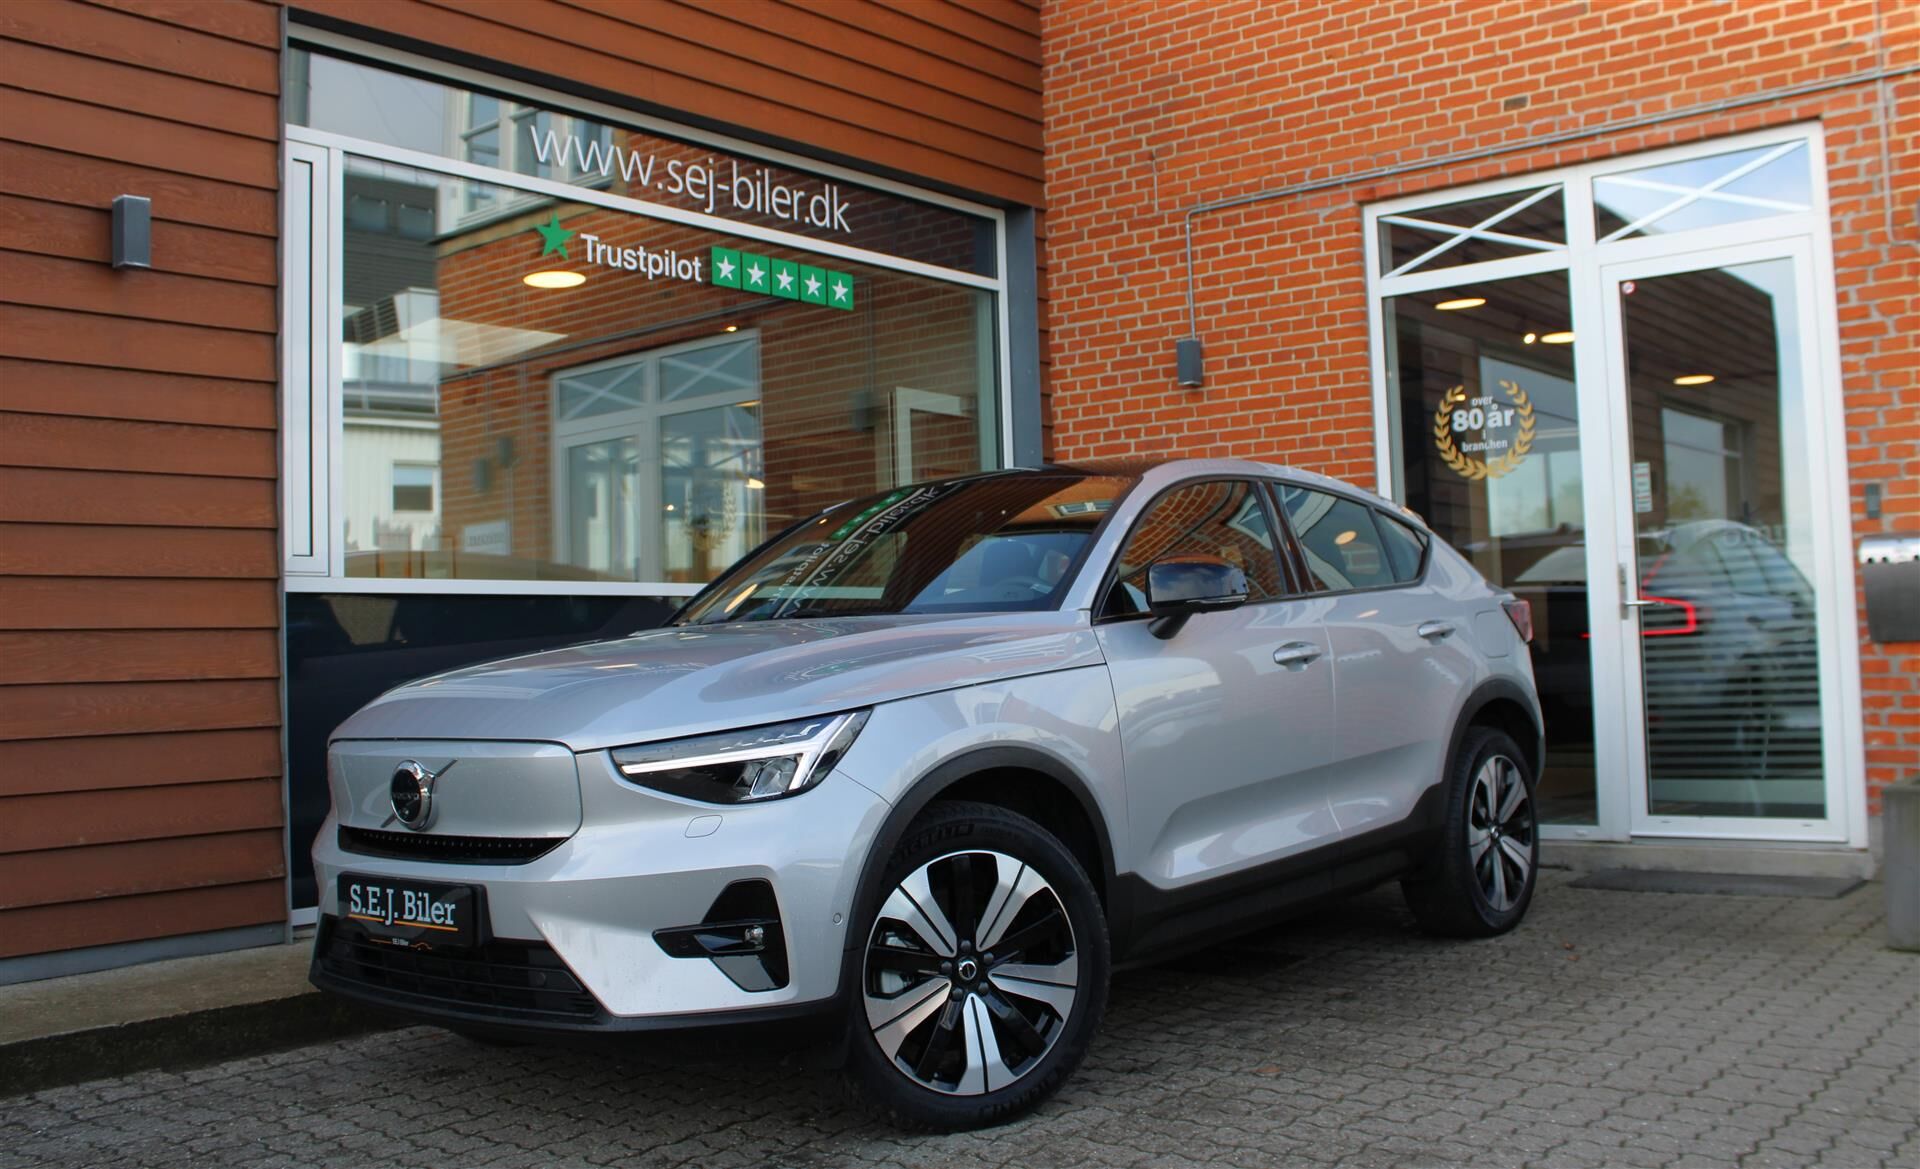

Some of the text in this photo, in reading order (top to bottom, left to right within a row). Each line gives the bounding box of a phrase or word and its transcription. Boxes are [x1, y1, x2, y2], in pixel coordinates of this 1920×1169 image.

[530, 125, 851, 233] www.sej-biler.dk
[580, 233, 702, 282] Trustpilot
[1452, 403, 1515, 432] 80 år
[1471, 396, 1493, 406] over
[1462, 439, 1508, 452] branchen
[350, 884, 456, 925] S.E.J. Biler
